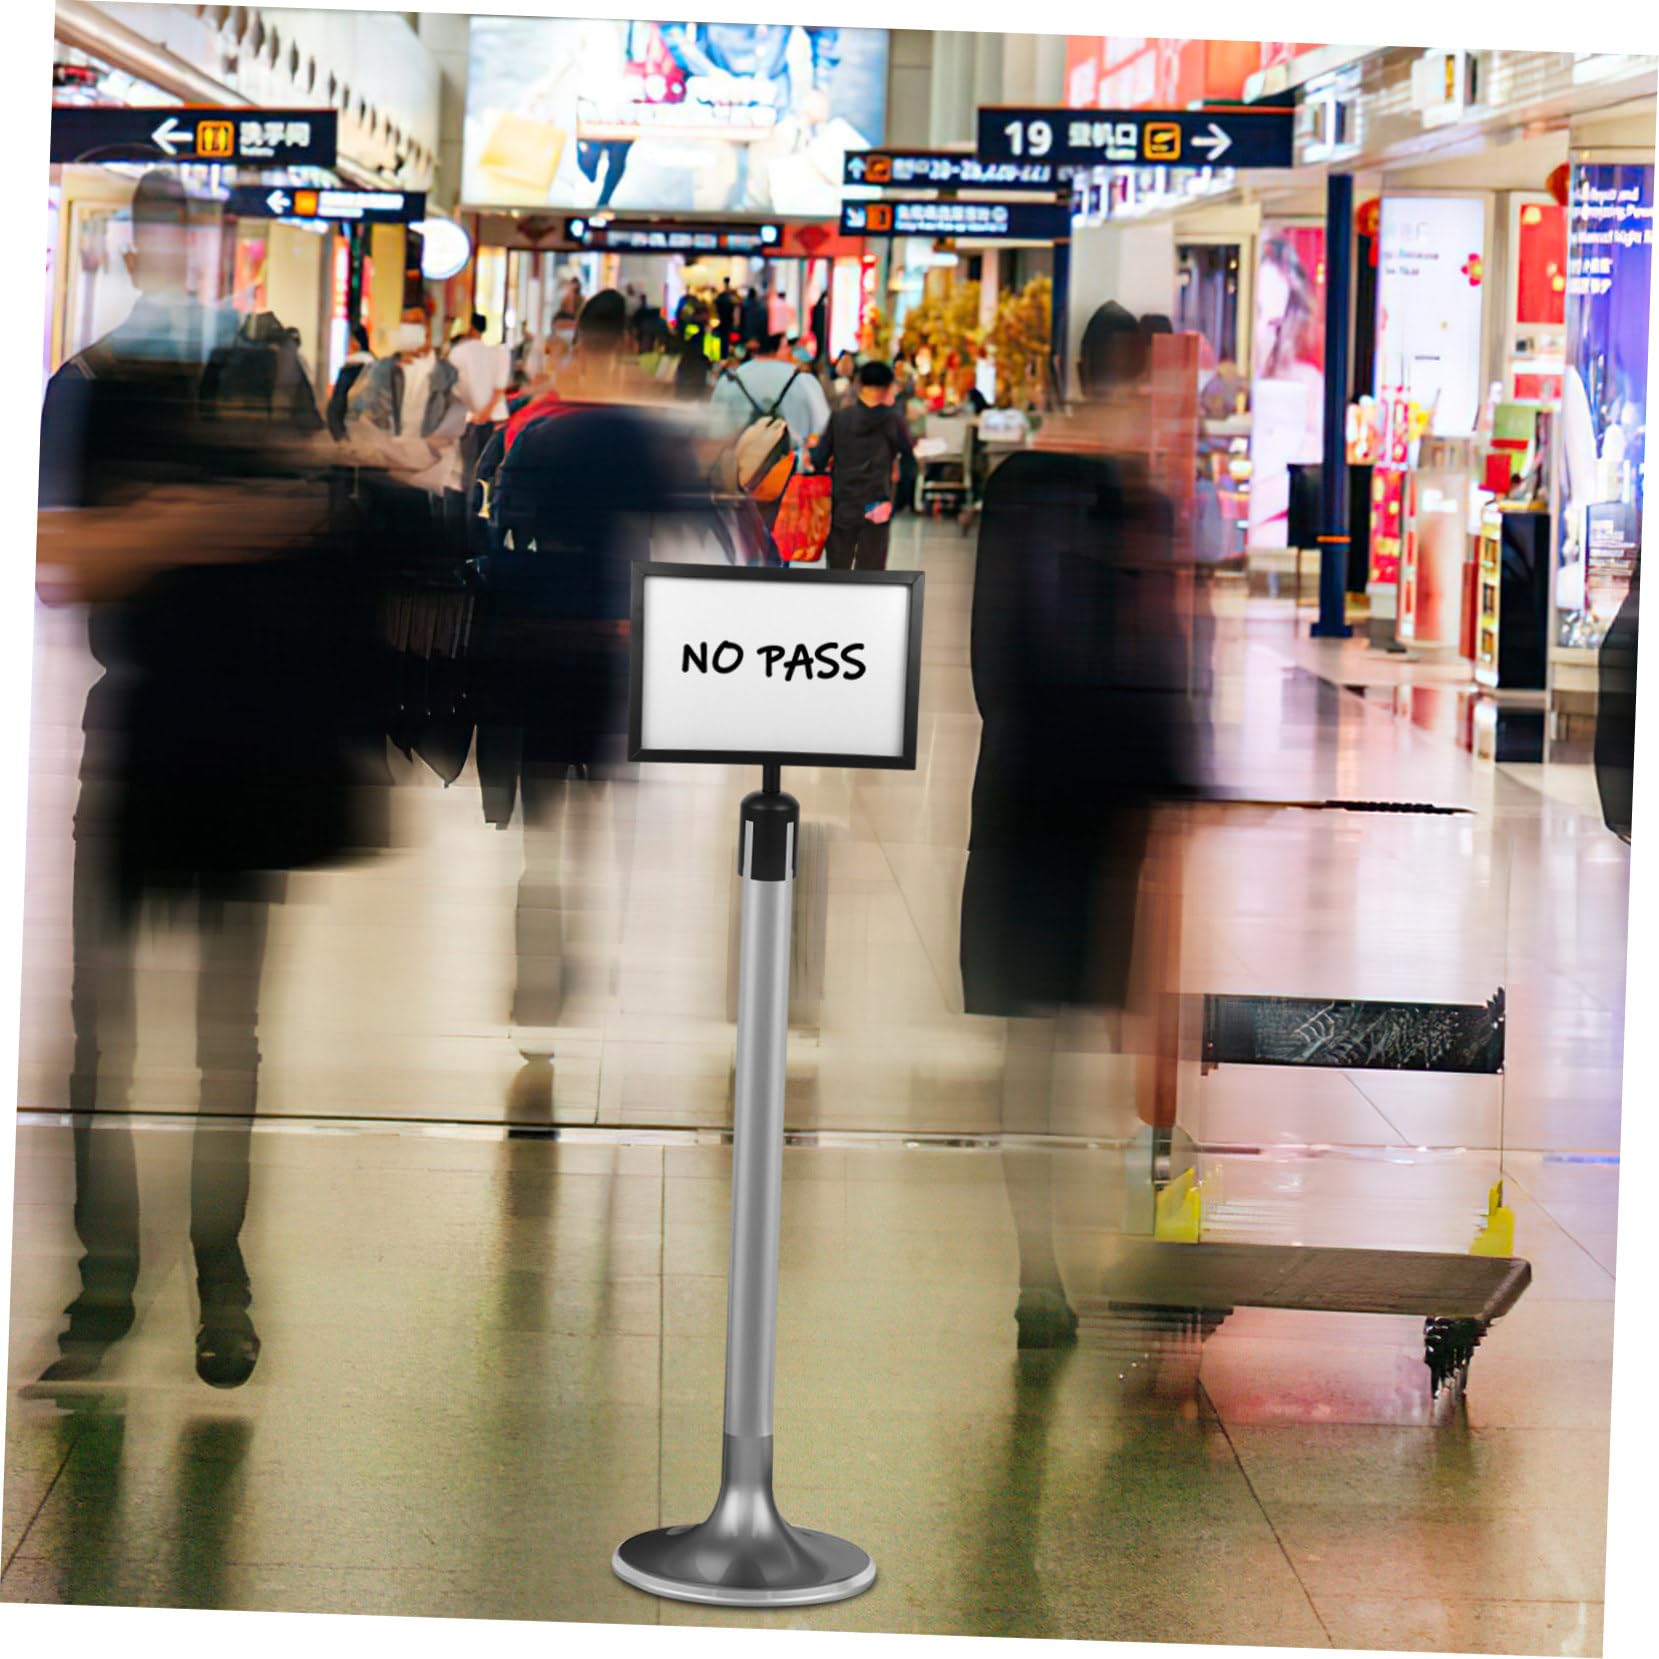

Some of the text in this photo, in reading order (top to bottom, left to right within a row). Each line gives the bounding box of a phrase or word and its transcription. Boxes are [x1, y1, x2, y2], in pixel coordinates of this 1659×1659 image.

[1004, 120, 1052, 156] 19
[682, 640, 866, 681] NO PASS
